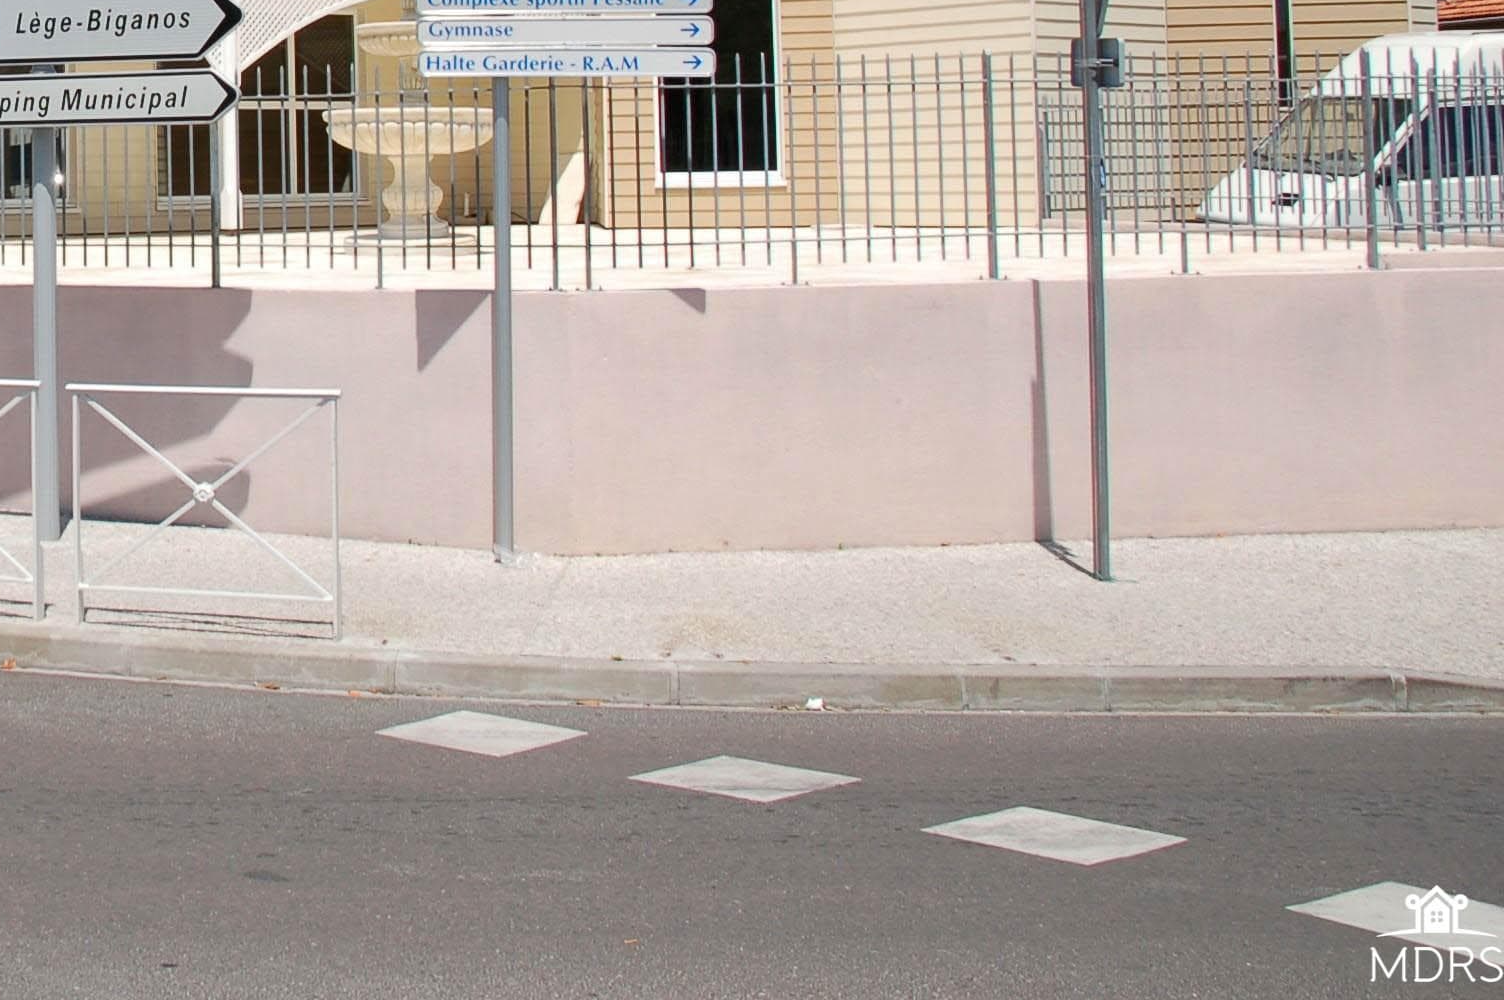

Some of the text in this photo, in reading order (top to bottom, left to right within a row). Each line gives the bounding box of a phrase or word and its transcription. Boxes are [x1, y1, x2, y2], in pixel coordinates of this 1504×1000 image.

[15, 8, 191, 40] Lège-Biganos
[428, 21, 514, 40] Gymnase
[426, 55, 476, 72] Halte
[482, 55, 565, 72] Garderie
[582, 55, 640, 72] R.A.M
[60, 85, 188, 115] Municipal
